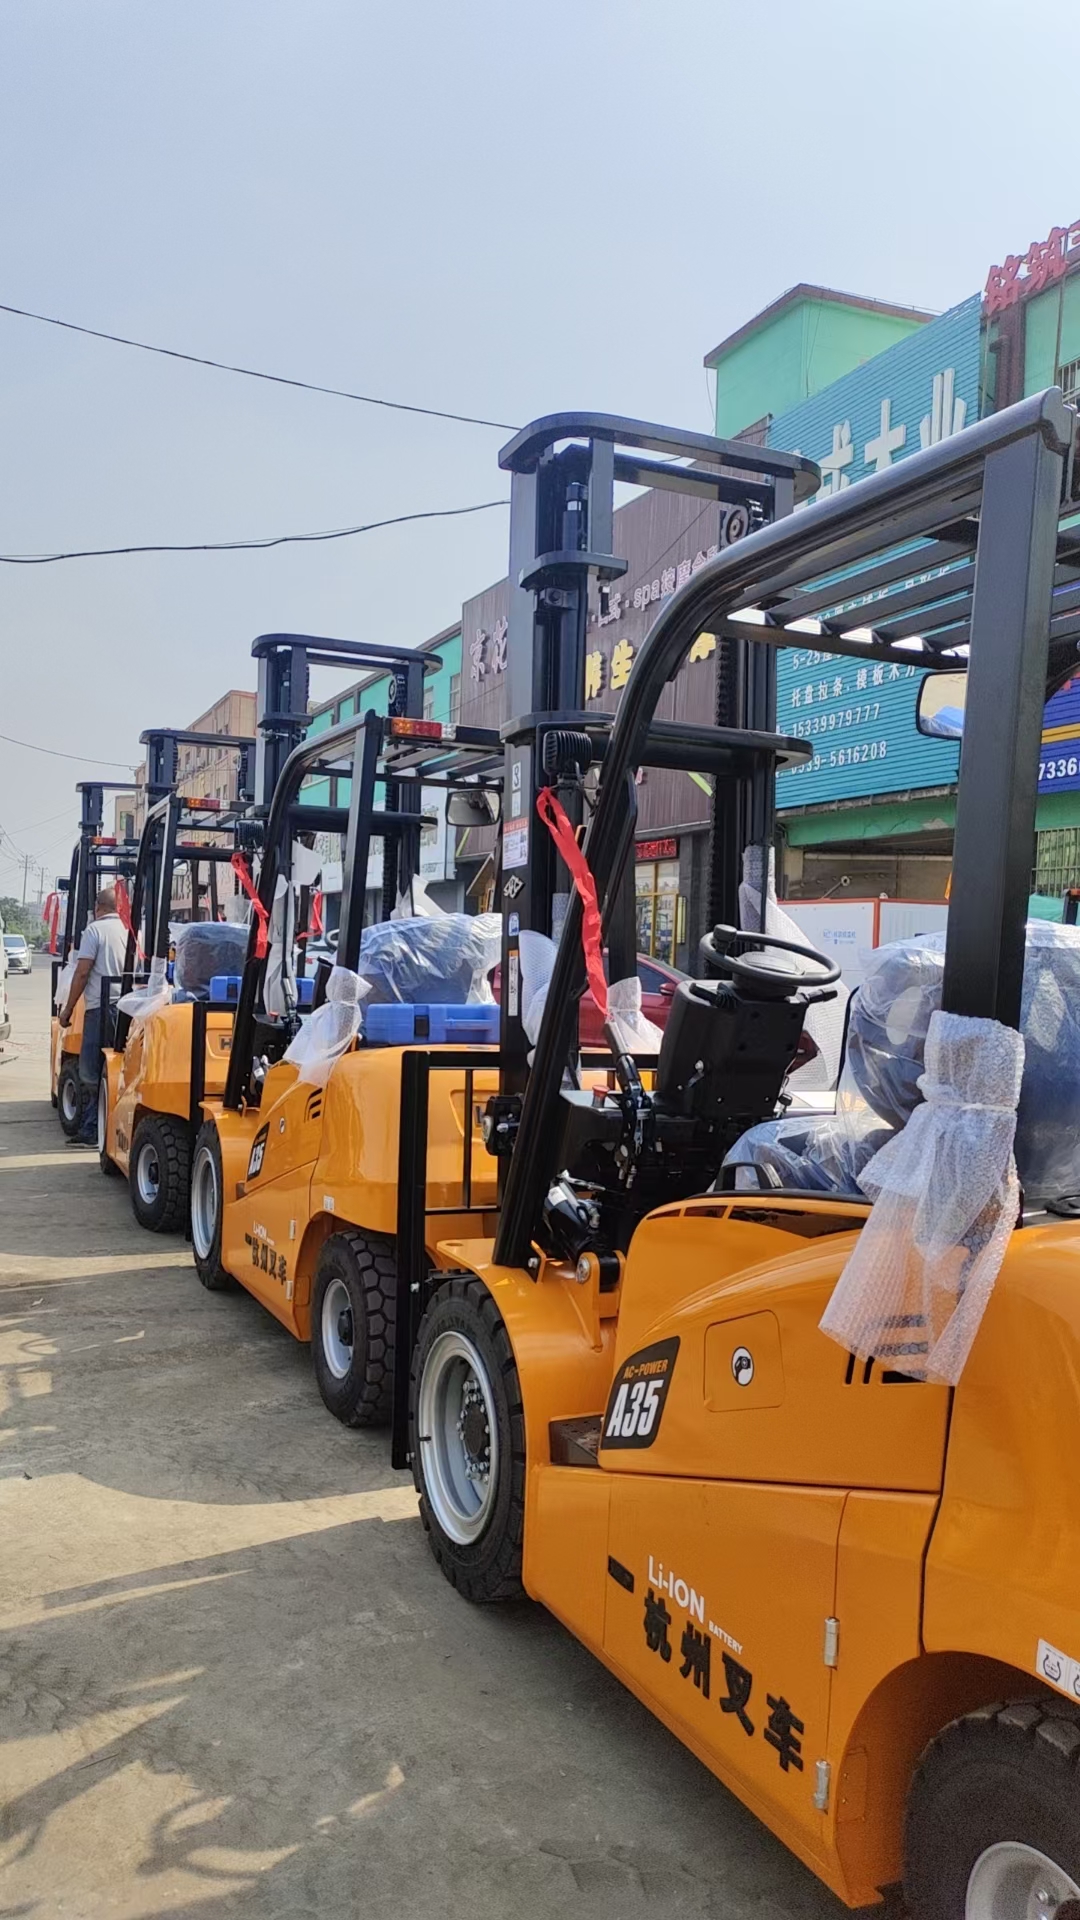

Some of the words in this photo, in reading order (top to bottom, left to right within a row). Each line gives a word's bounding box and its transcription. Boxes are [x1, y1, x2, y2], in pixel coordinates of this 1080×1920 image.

[792, 703, 880, 737] 15339979777
[1038, 757, 1080, 780] 7336
[623, 1359, 669, 1379] AC-POWER
[605, 1380, 664, 1437] A35
[648, 1555, 704, 1624] Li-ION
[708, 1620, 743, 1655] BATTERY
[643, 1587, 805, 1774] 杭州叉车
